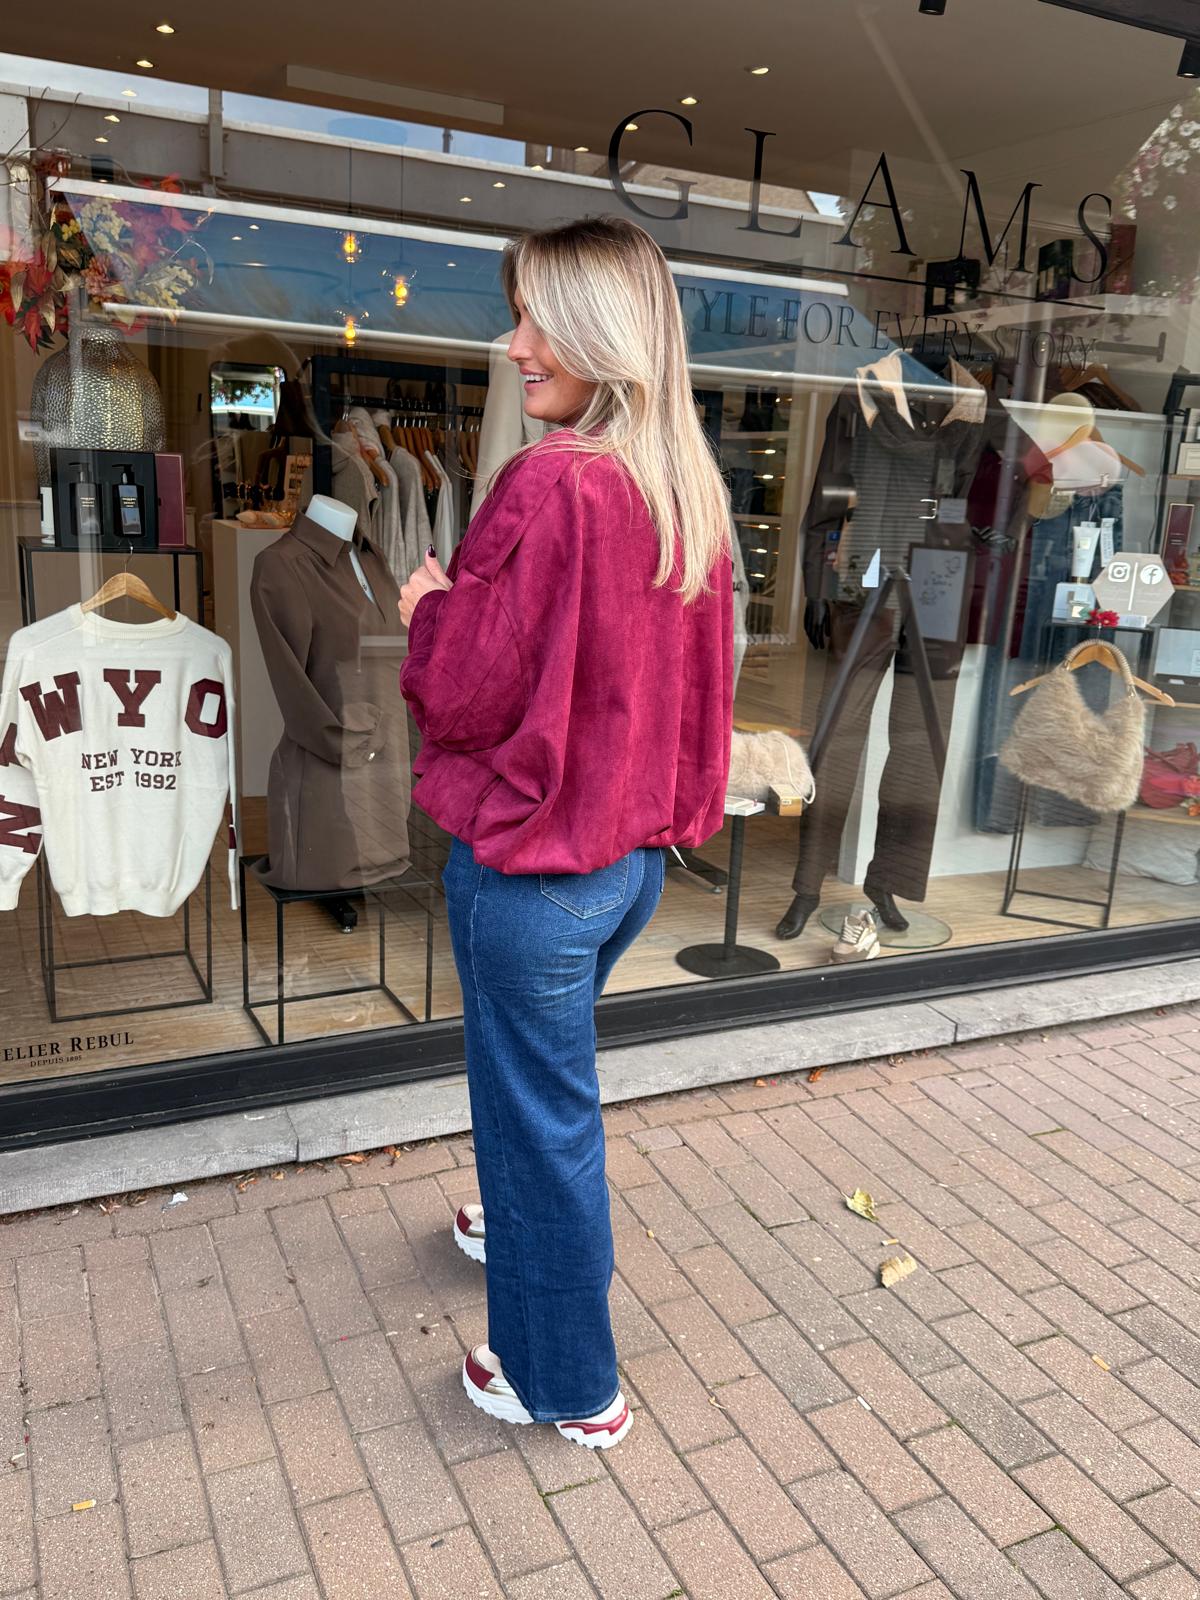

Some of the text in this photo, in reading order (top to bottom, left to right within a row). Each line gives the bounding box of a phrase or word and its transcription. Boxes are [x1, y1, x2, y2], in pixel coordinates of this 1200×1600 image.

[608, 109, 1113, 283] GLAMS
[677, 286, 1098, 372] TYLE FOR EVERY STORY
[81, 748, 182, 770] NEW YORK
[89, 770, 177, 792] EST 1992
[0, 1031, 134, 1061] ELIER REBUL
[30, 1057, 64, 1068] DEPUIS
